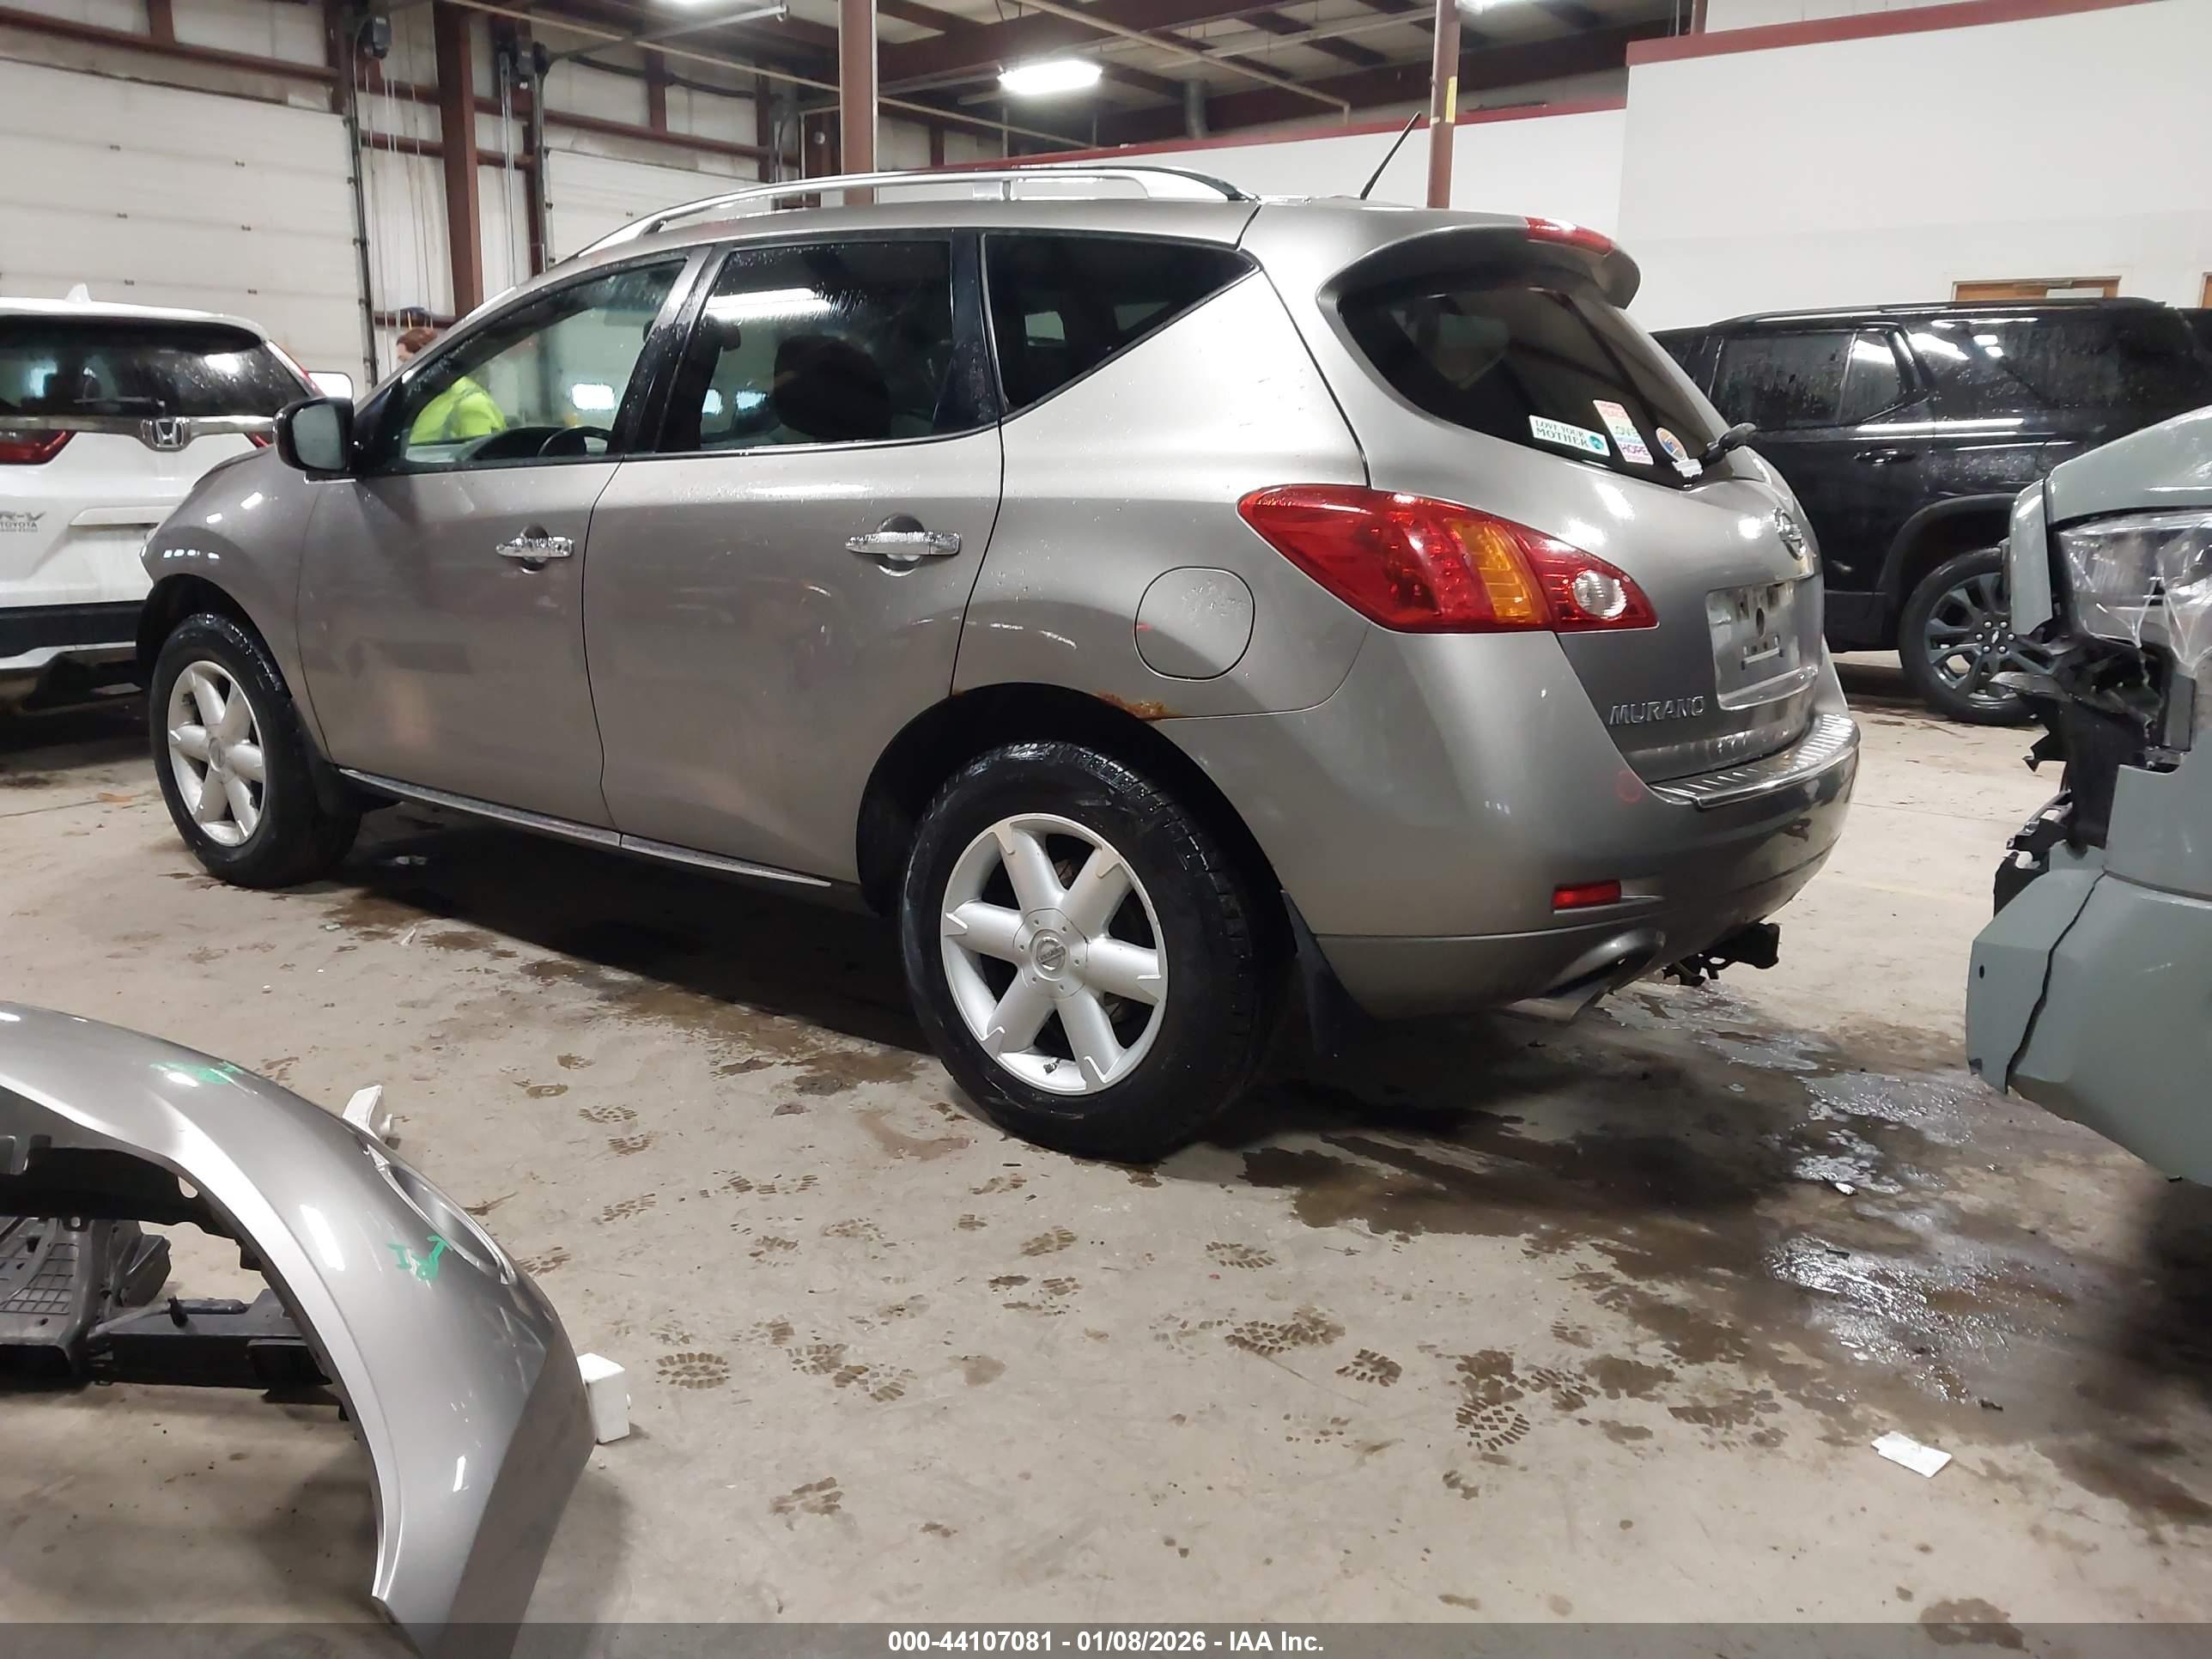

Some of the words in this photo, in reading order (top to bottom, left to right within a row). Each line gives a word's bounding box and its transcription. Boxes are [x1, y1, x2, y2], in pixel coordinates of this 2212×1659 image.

[1535, 420, 1558, 431] LOVE
[1560, 426, 1585, 438] YOUR
[1536, 428, 1589, 447] MOTHER
[1620, 442, 1650, 456] HOPE
[1609, 696, 1705, 726] MURANO
